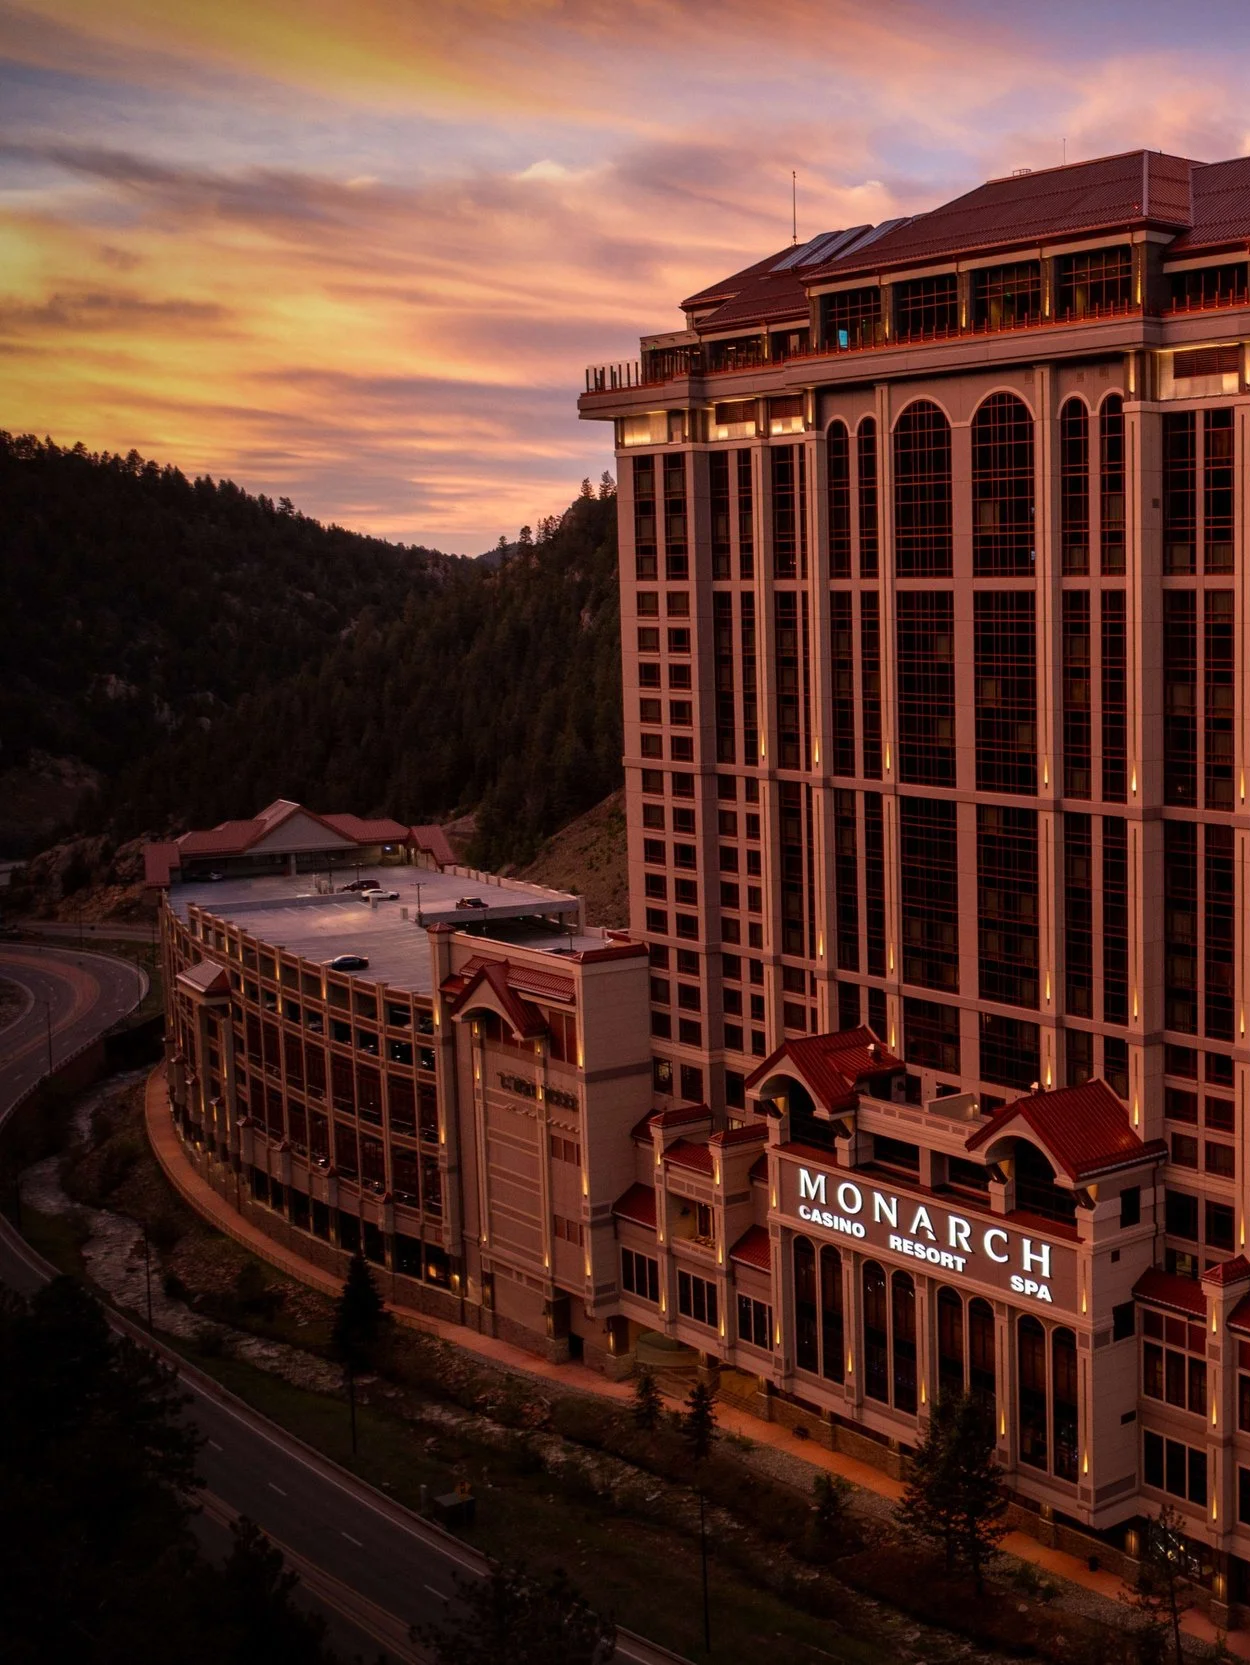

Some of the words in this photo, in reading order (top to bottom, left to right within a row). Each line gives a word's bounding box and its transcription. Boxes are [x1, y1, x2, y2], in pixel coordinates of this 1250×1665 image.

[798, 1204, 866, 1238] CASINO
[889, 1234, 967, 1273] RESORT
[1010, 1274, 1053, 1303] SPA
[799, 1168, 1052, 1278] MONARCH
